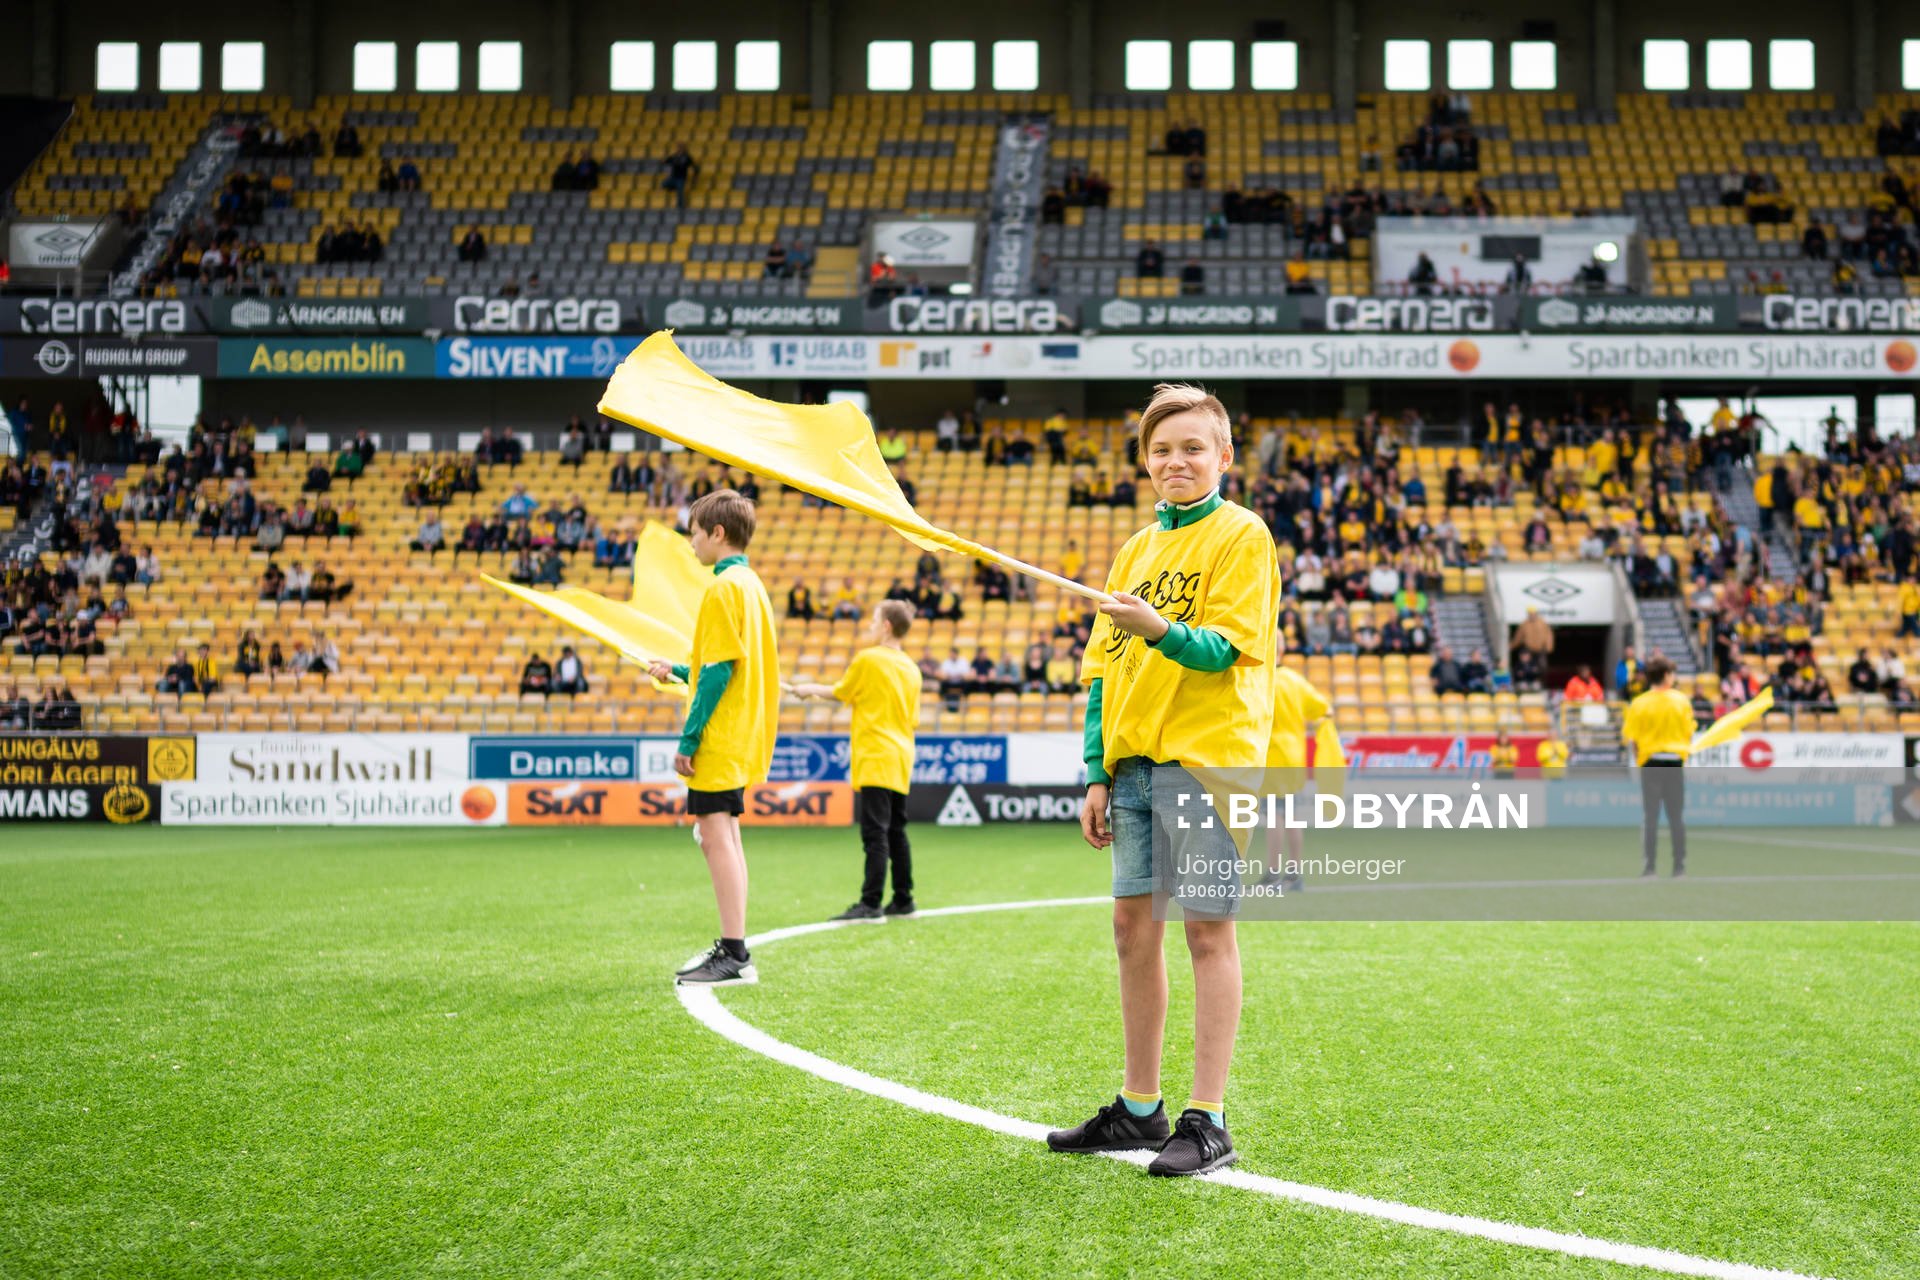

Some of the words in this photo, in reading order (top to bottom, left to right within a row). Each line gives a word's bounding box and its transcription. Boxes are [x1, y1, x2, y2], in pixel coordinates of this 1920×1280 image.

[889, 296, 1058, 332] Cernera
[85, 348, 142, 366] RUDHOLM
[146, 348, 188, 366] GROUP
[249, 342, 406, 373] Assemblin
[1131, 341, 1304, 372] Sparbanken
[1311, 341, 1439, 377] Sjuhärad
[1567, 341, 1740, 373] Sparbanken
[1749, 340, 1876, 376] Sjuhärad
[0, 736, 100, 761] UNGÄLVS
[509, 751, 631, 776] Danske
[229, 747, 432, 783] Sandwall
[170, 789, 327, 820] Sparbanken
[336, 789, 452, 820] Sjuhärad
